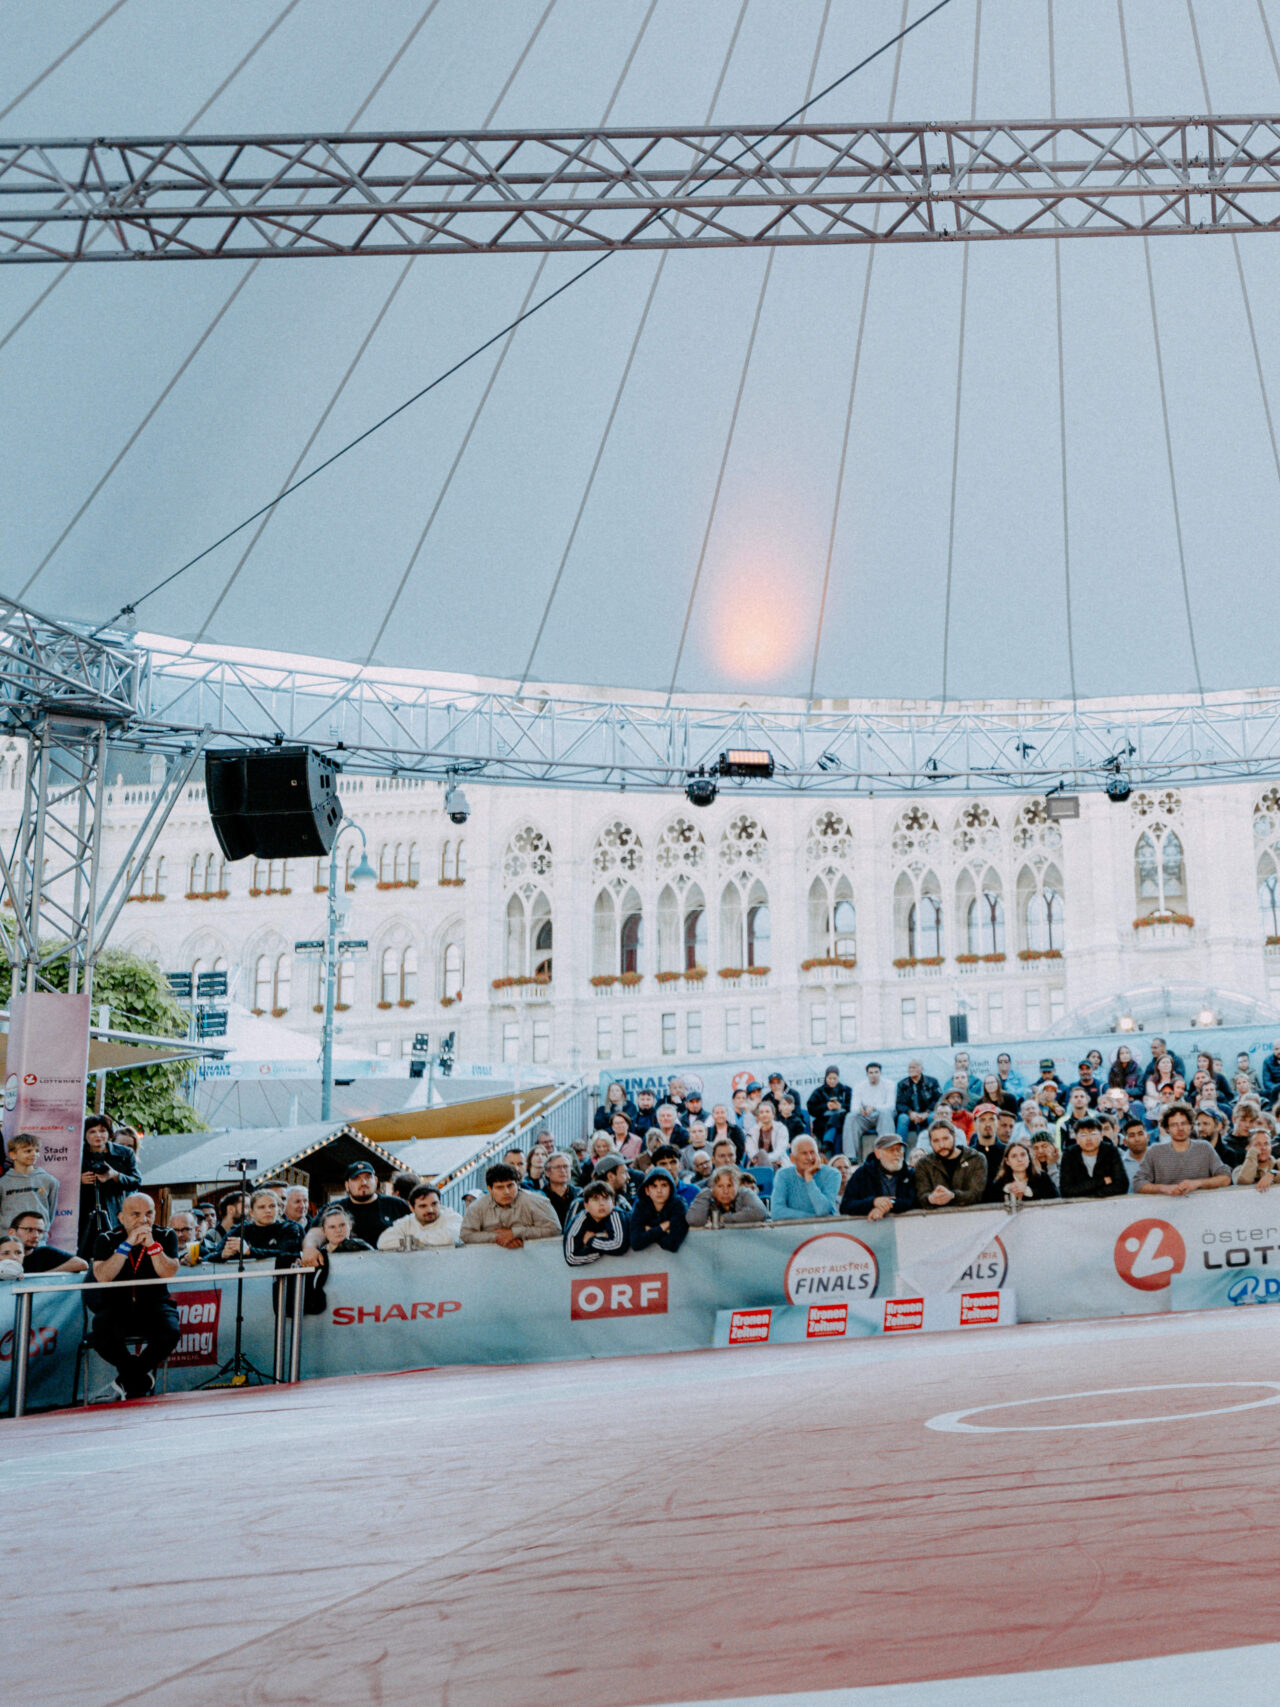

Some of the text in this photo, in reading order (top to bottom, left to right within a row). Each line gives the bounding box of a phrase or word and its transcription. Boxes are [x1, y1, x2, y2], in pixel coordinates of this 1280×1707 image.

[44, 1146, 68, 1154] Stadt
[44, 1154, 68, 1162] Wien
[796, 1262, 869, 1275] SPORT AUSTRIA
[962, 1262, 998, 1281] ALS
[795, 1273, 870, 1294] FINALS
[578, 1281, 661, 1312] ORF
[961, 1295, 998, 1309] Kronen
[332, 1301, 462, 1325] SHARP
[809, 1308, 847, 1320] Kronen
[887, 1302, 922, 1314] Kronen
[962, 1307, 998, 1320] Zeitung
[732, 1314, 769, 1326] Kronen
[808, 1319, 845, 1333] Zeitung
[886, 1313, 922, 1326] Zeitung
[731, 1325, 768, 1339] Zeitung
